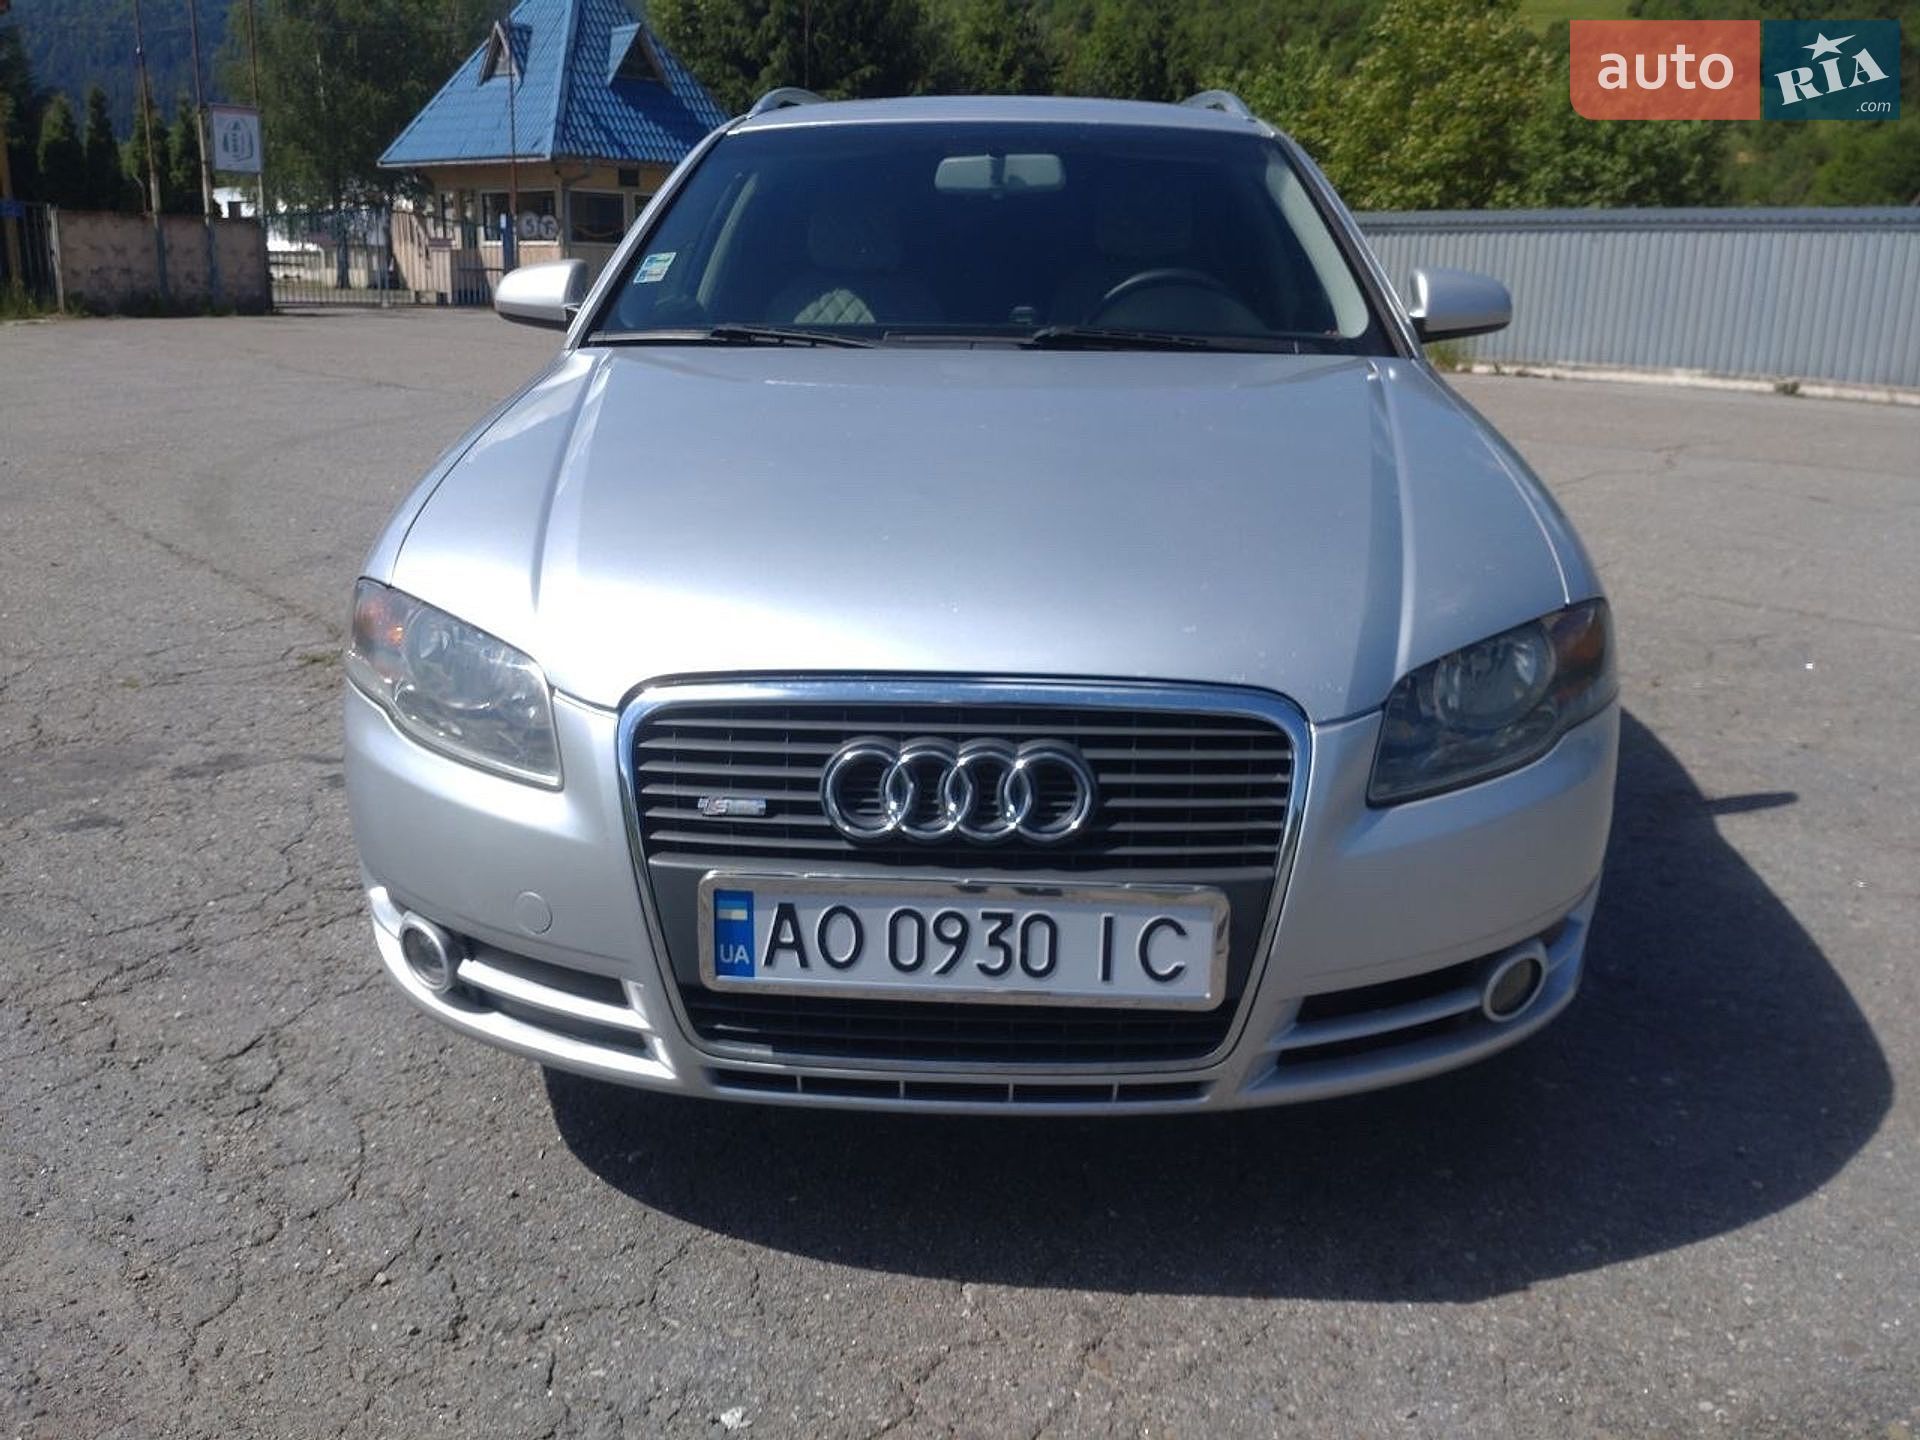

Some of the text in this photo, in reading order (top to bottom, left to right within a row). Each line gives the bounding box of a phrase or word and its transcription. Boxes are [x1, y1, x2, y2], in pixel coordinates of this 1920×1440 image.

[720, 943, 750, 965] UA
[762, 902, 1188, 983] AO 0930 IC
